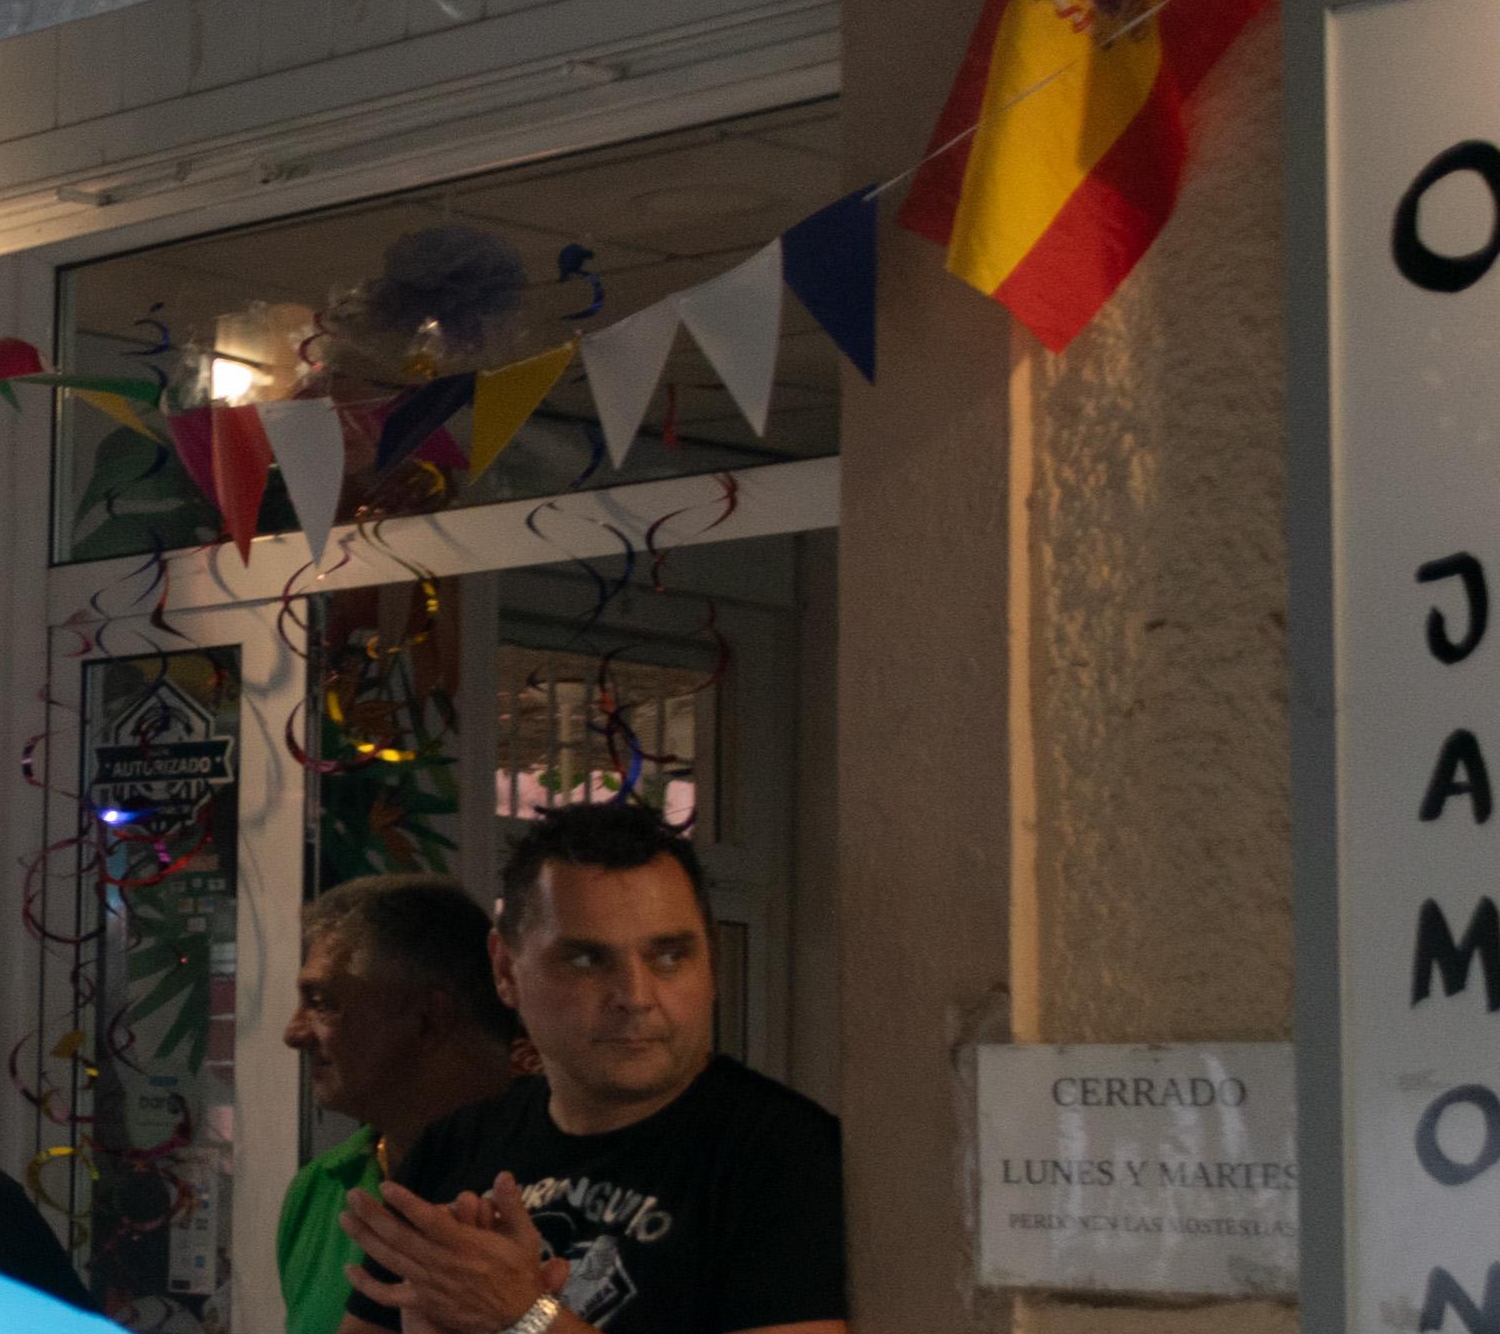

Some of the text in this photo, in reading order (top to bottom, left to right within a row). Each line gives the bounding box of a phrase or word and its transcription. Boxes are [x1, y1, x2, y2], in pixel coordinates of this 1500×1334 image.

[1051, 1077, 1248, 1107] CERRADO
[1002, 1158, 1300, 1190] LUNES Y MARTES
